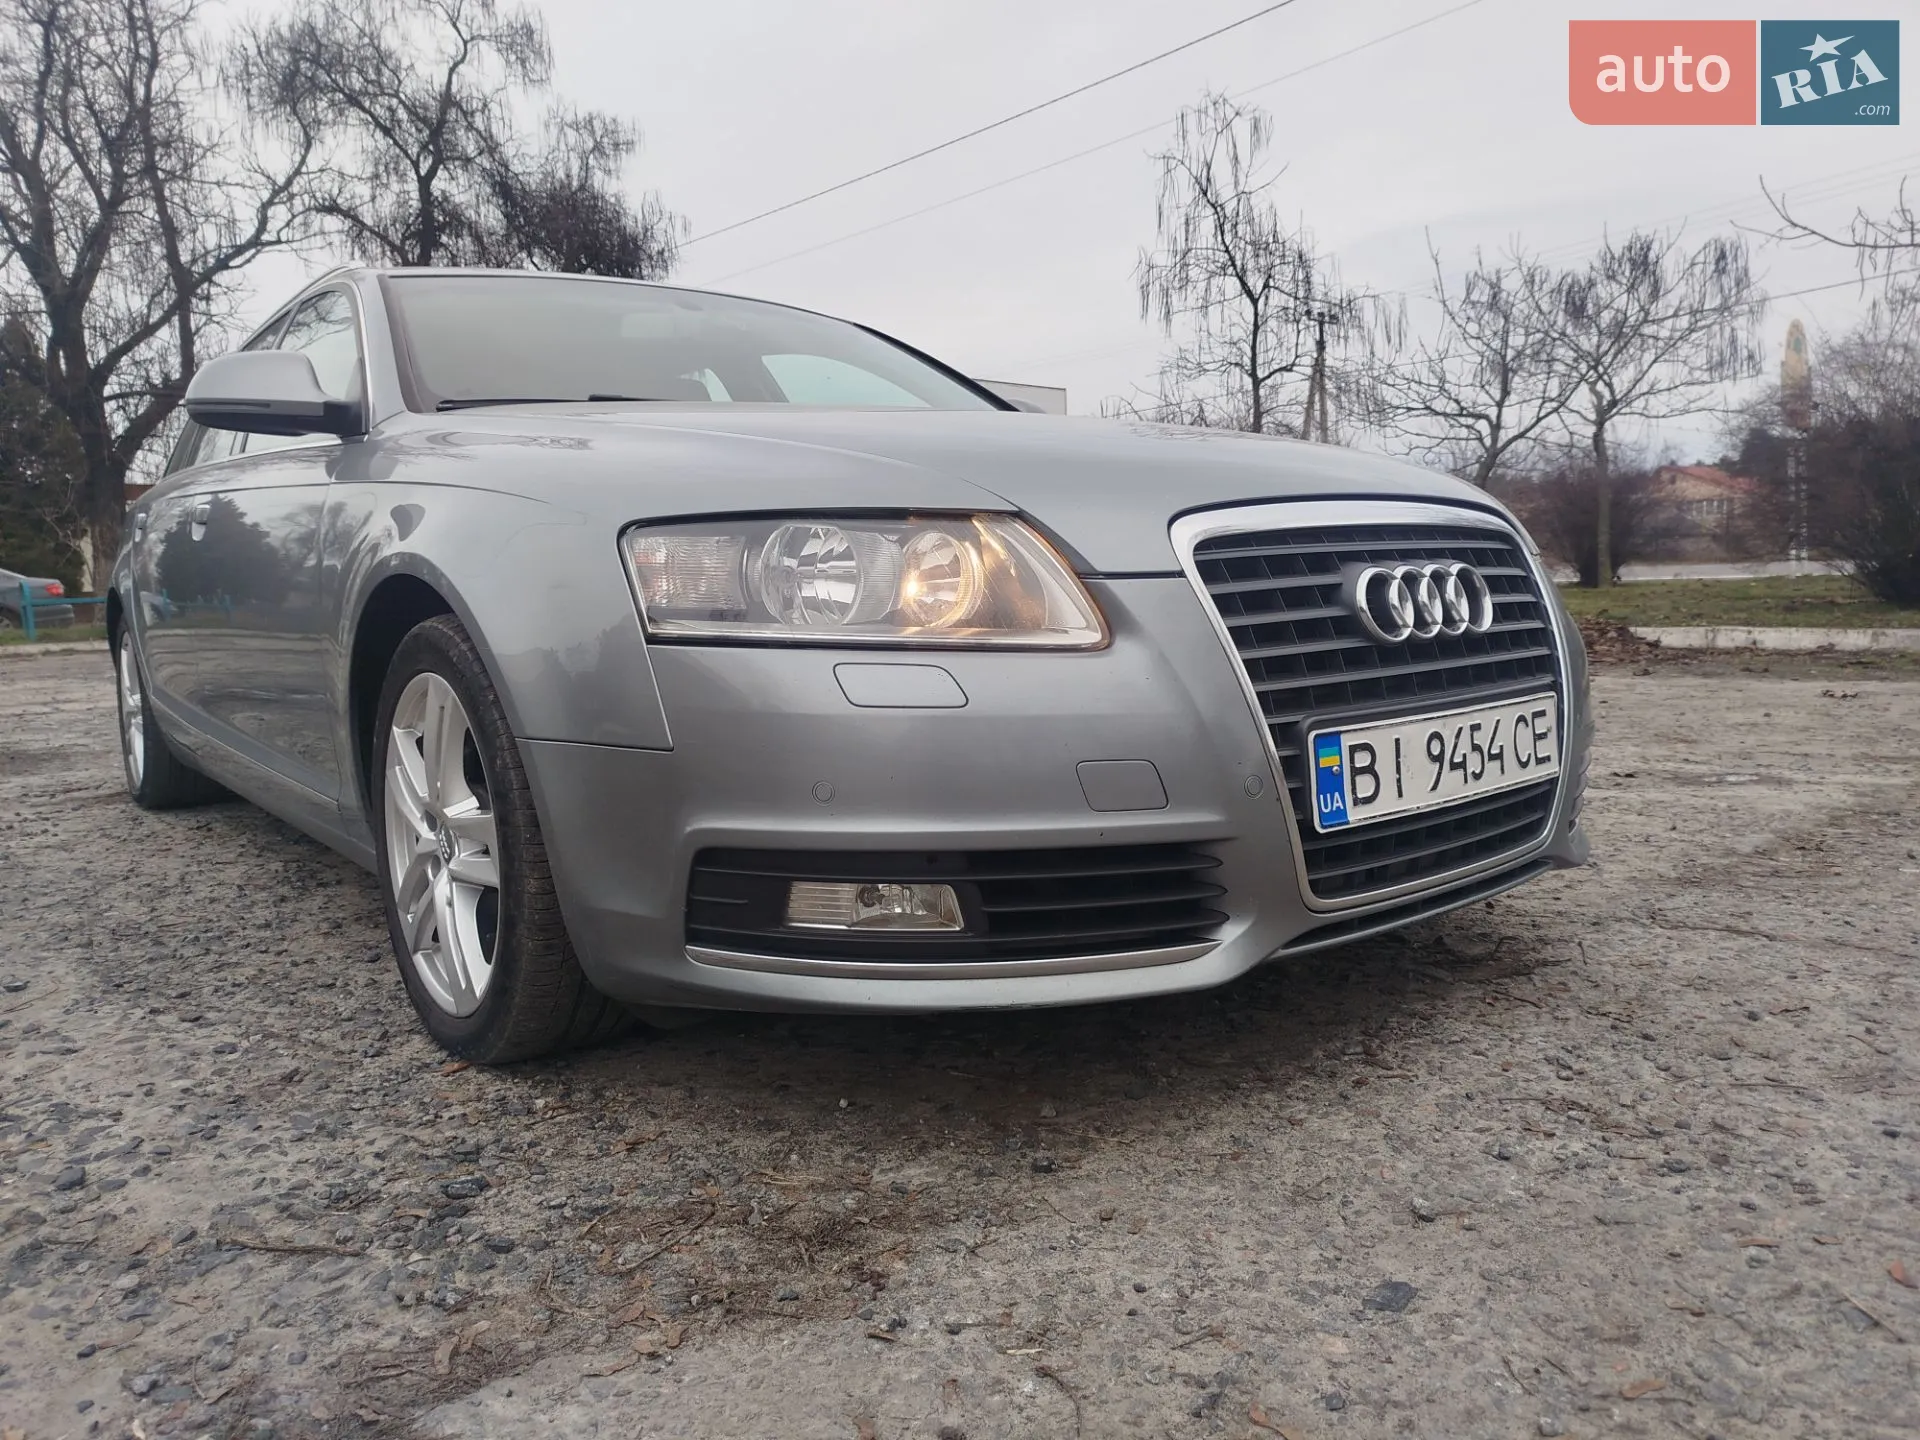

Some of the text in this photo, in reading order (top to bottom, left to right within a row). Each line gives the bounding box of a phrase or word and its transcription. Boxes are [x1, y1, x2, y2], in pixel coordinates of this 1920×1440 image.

[1348, 708, 1552, 807] BI 9454 CE
[1319, 792, 1344, 813] UA
